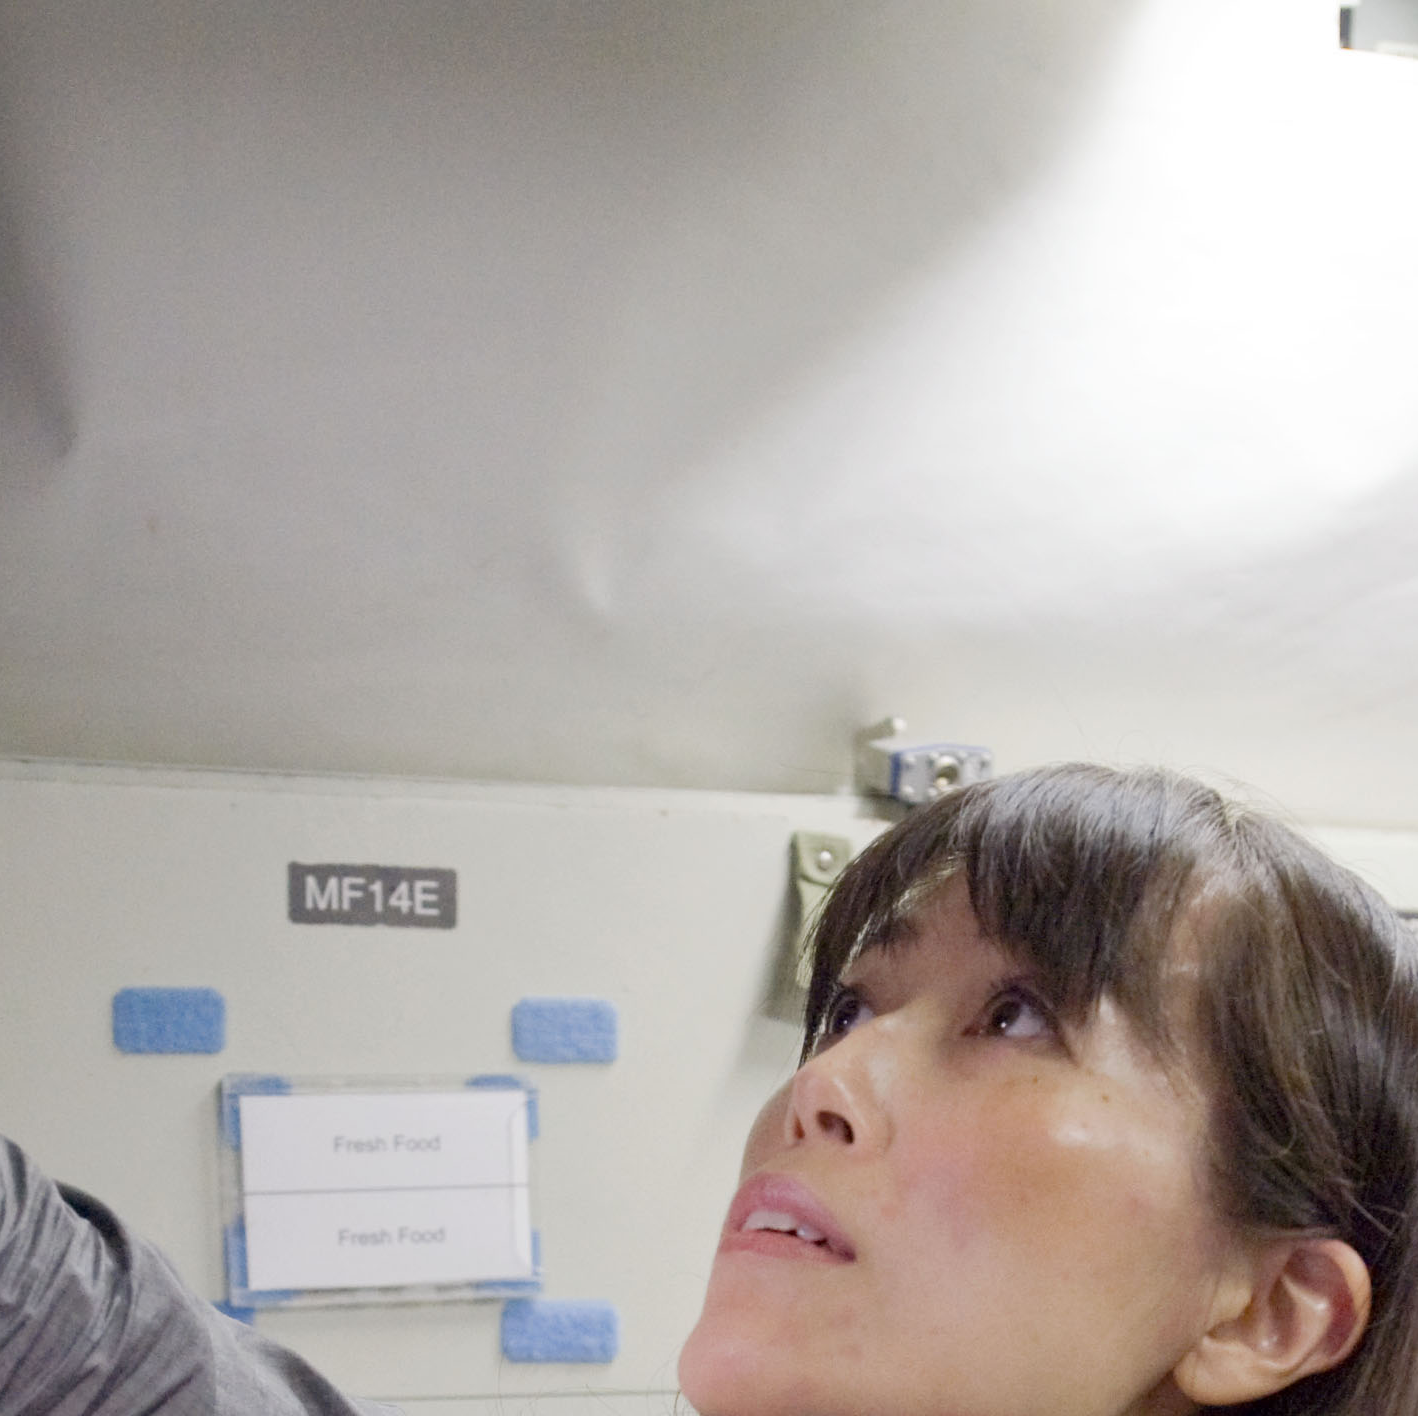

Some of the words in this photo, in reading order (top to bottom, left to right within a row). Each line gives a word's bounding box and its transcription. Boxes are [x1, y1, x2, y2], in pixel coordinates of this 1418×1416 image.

[303, 875, 441, 917] MF14E
[333, 1134, 388, 1153] Fresh
[392, 1133, 441, 1153] Food
[338, 1227, 393, 1246] Fresh
[397, 1225, 446, 1244] Food
